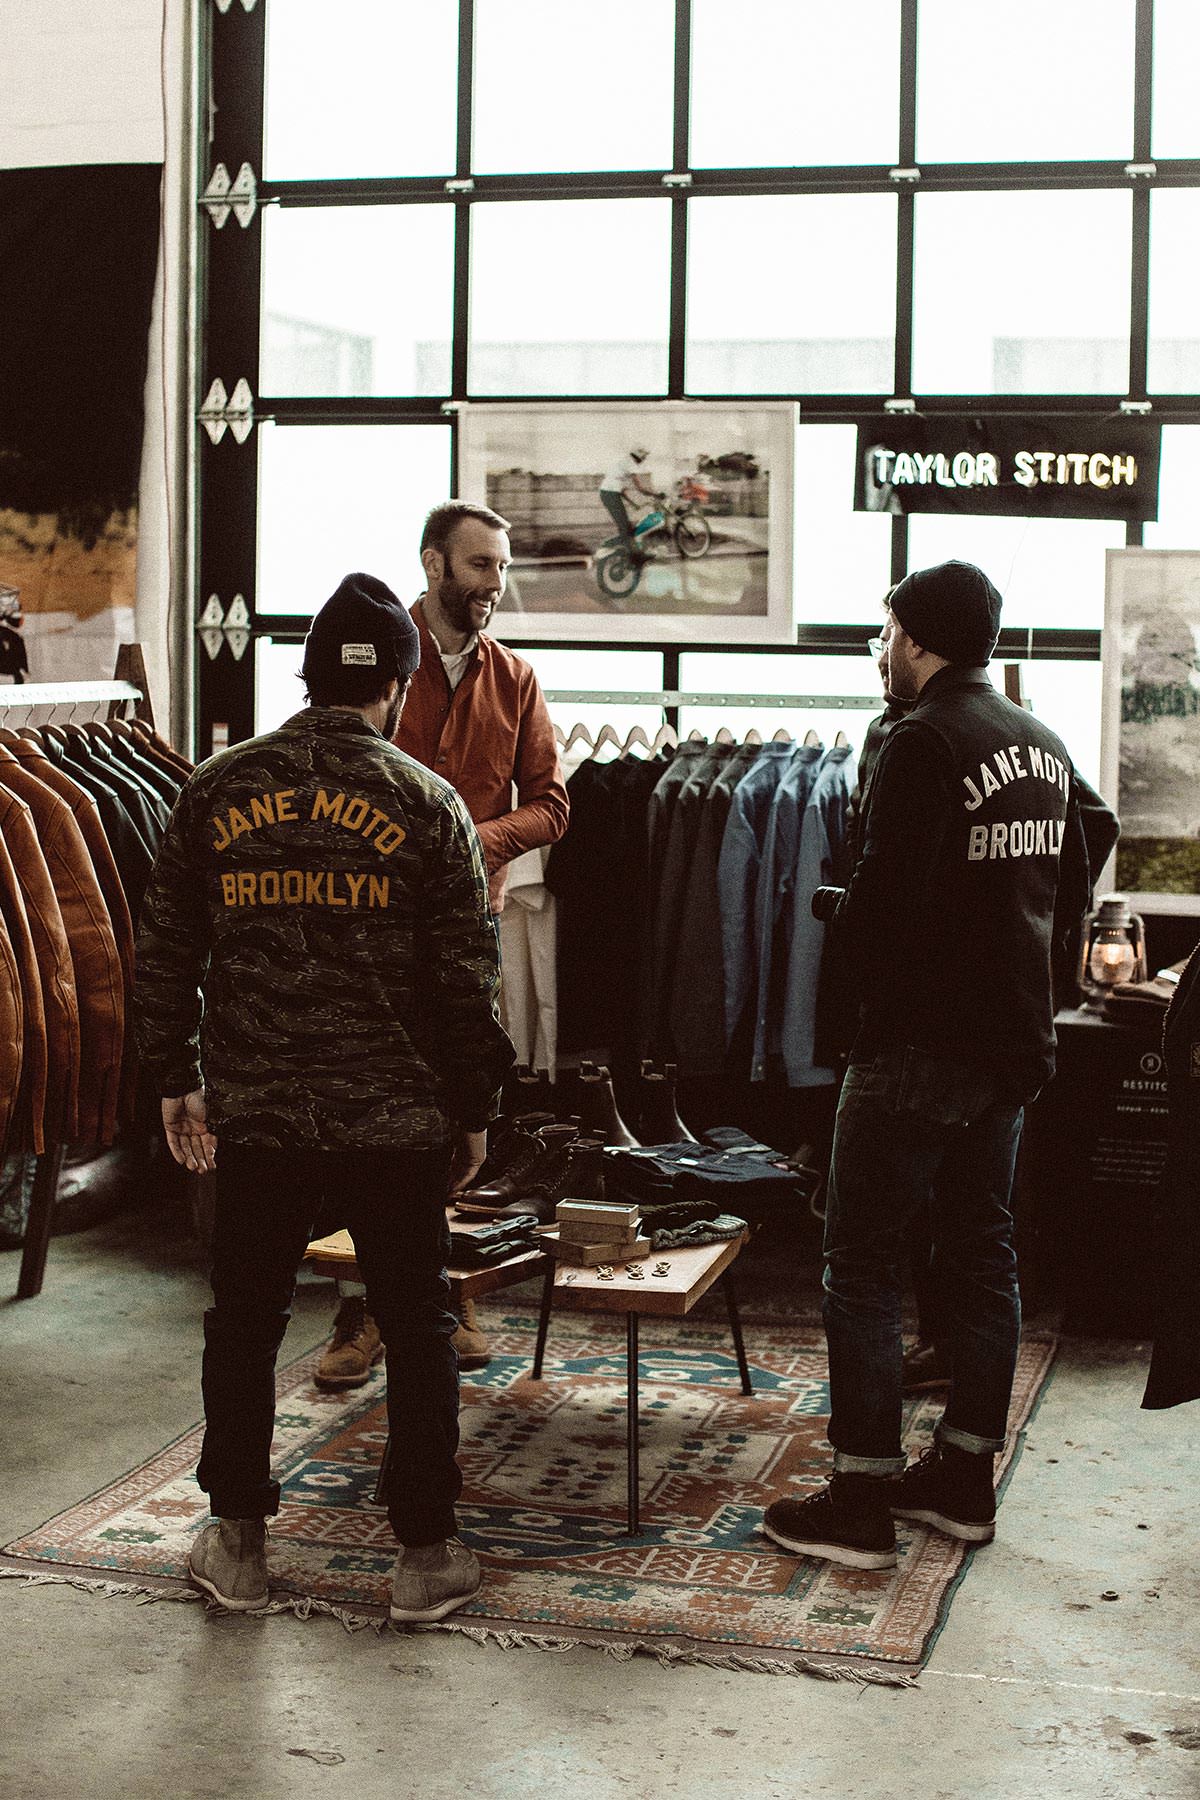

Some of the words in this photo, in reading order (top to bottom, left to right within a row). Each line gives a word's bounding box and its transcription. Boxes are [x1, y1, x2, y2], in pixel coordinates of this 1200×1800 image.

[874, 449, 999, 488] TAYLOR
[1013, 450, 1136, 488] STITCH
[962, 745, 1028, 811] JANE
[212, 789, 299, 851] JANE
[310, 789, 407, 856] MOTO
[220, 870, 390, 909] BROOKLYN
